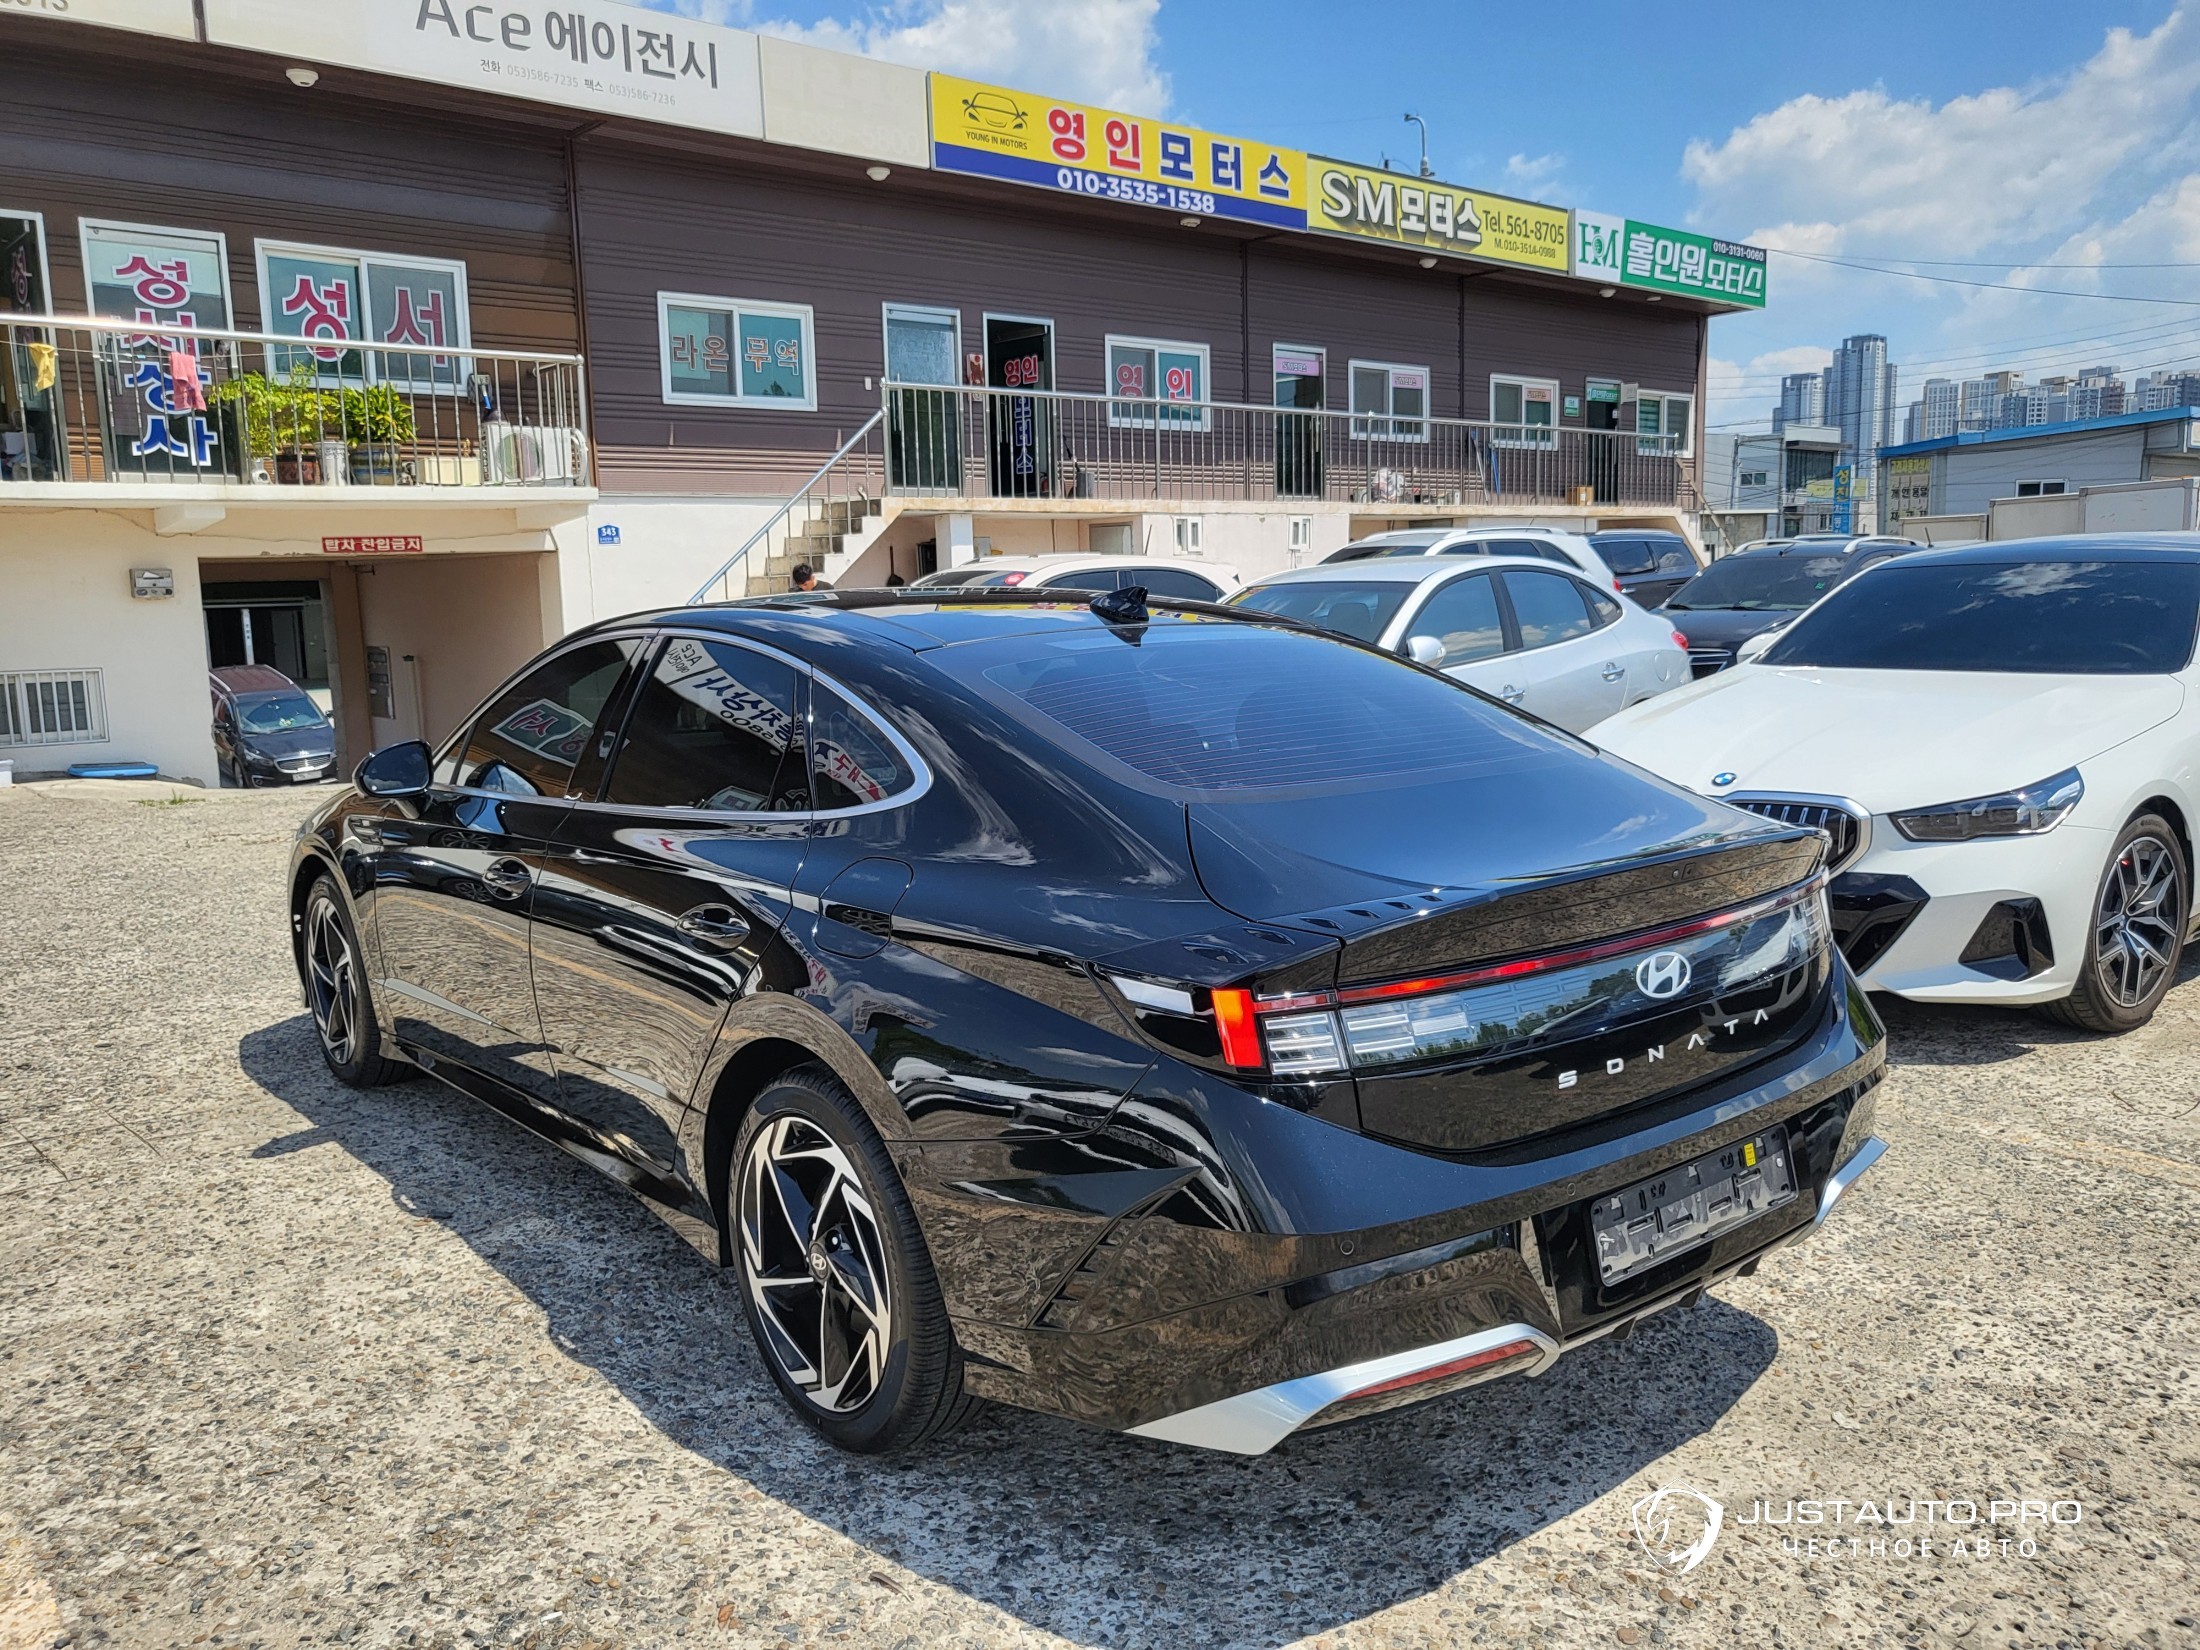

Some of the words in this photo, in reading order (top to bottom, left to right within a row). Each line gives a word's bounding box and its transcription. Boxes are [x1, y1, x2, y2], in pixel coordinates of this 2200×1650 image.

[416, 0, 532, 51] Ace
[545, 11, 718, 89] 에이전시
[480, 59, 501, 74] 전화
[507, 65, 579, 88] 053)586-7235
[584, 78, 604, 92] 팩스
[966, 131, 991, 144] YOUNG
[991, 135, 999, 145] IN
[999, 138, 1028, 150] MOTORS
[1057, 168, 1216, 214] 010-3535-1538
[1321, 170, 1483, 244] SM모터스
[1627, 231, 1707, 287] 홀인원
[1704, 258, 1763, 298] 모터스
[745, 336, 799, 376] 무역
[1004, 355, 1038, 387] 영인
[361, 537, 420, 551] 진입금지
[601, 527, 616, 537] 343
[1558, 1008, 1769, 1089] SONATA
